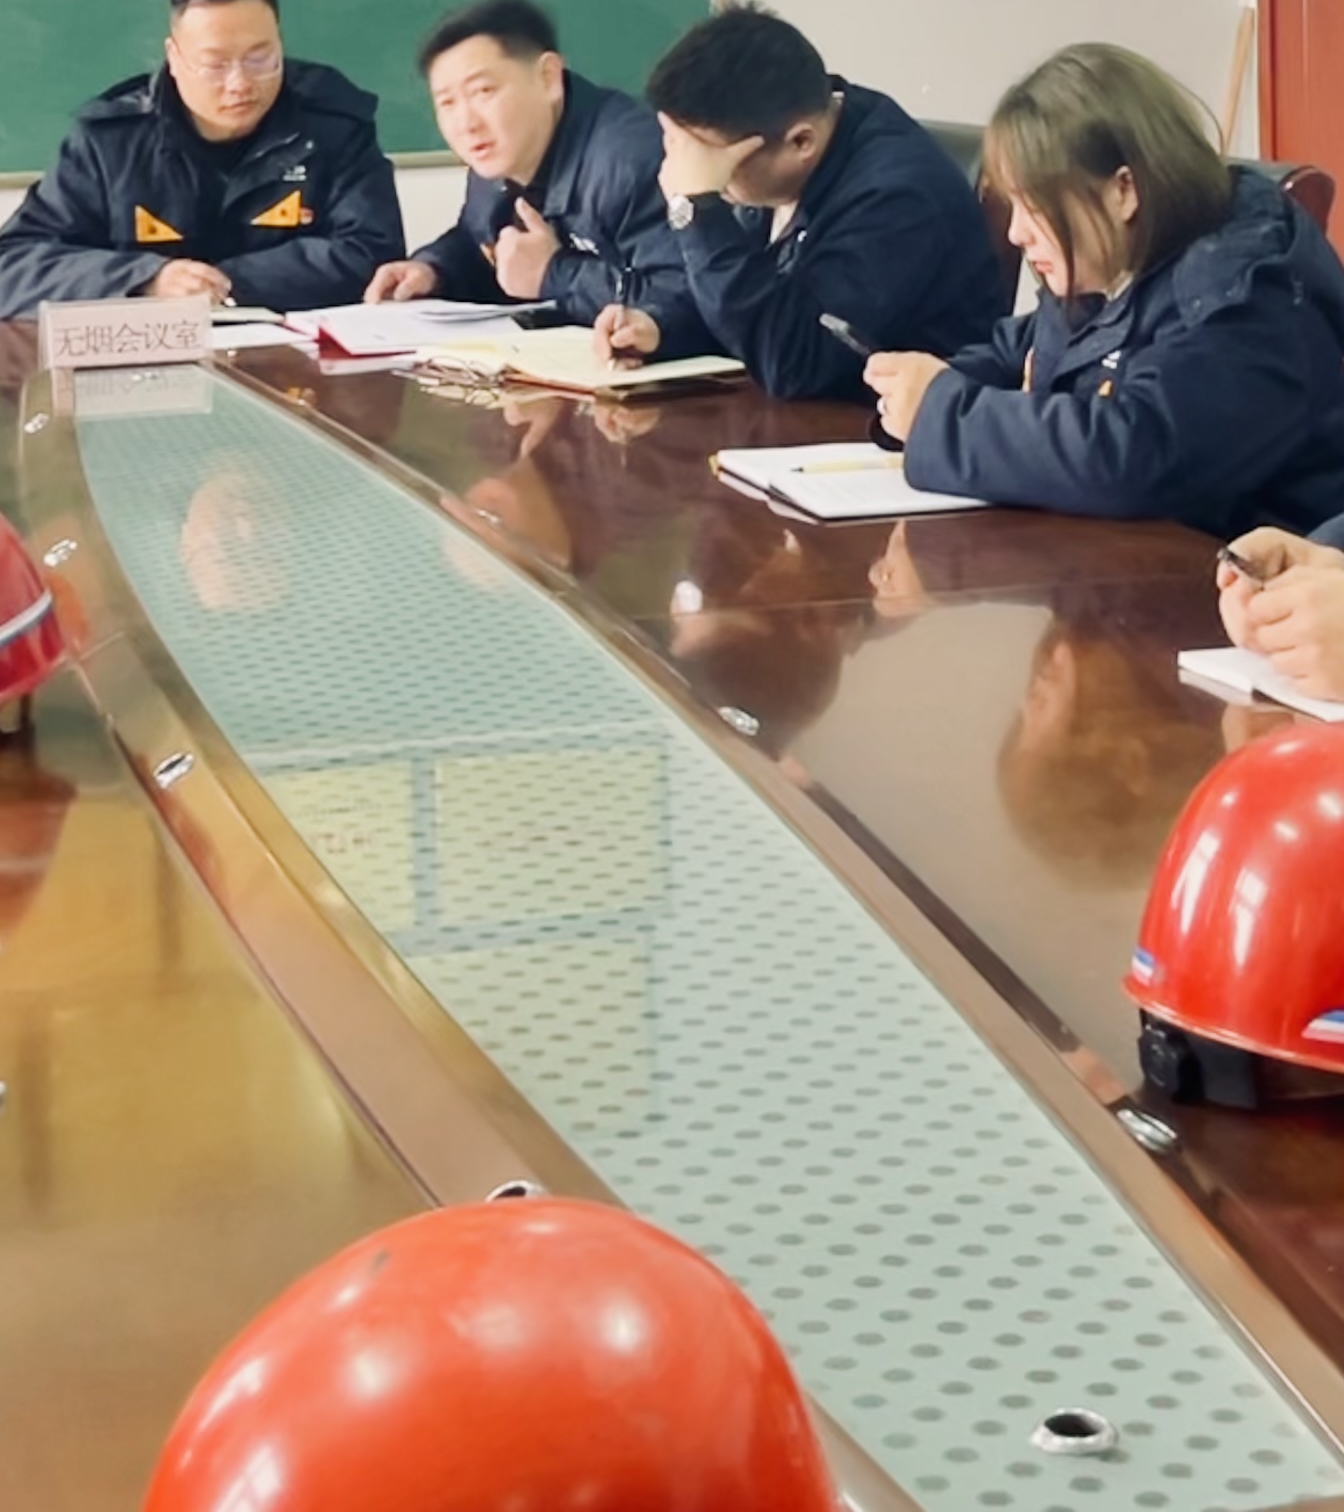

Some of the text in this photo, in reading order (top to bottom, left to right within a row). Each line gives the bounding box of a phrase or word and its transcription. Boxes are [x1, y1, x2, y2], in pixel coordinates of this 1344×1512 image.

[55, 320, 204, 357] 无烟会议室
